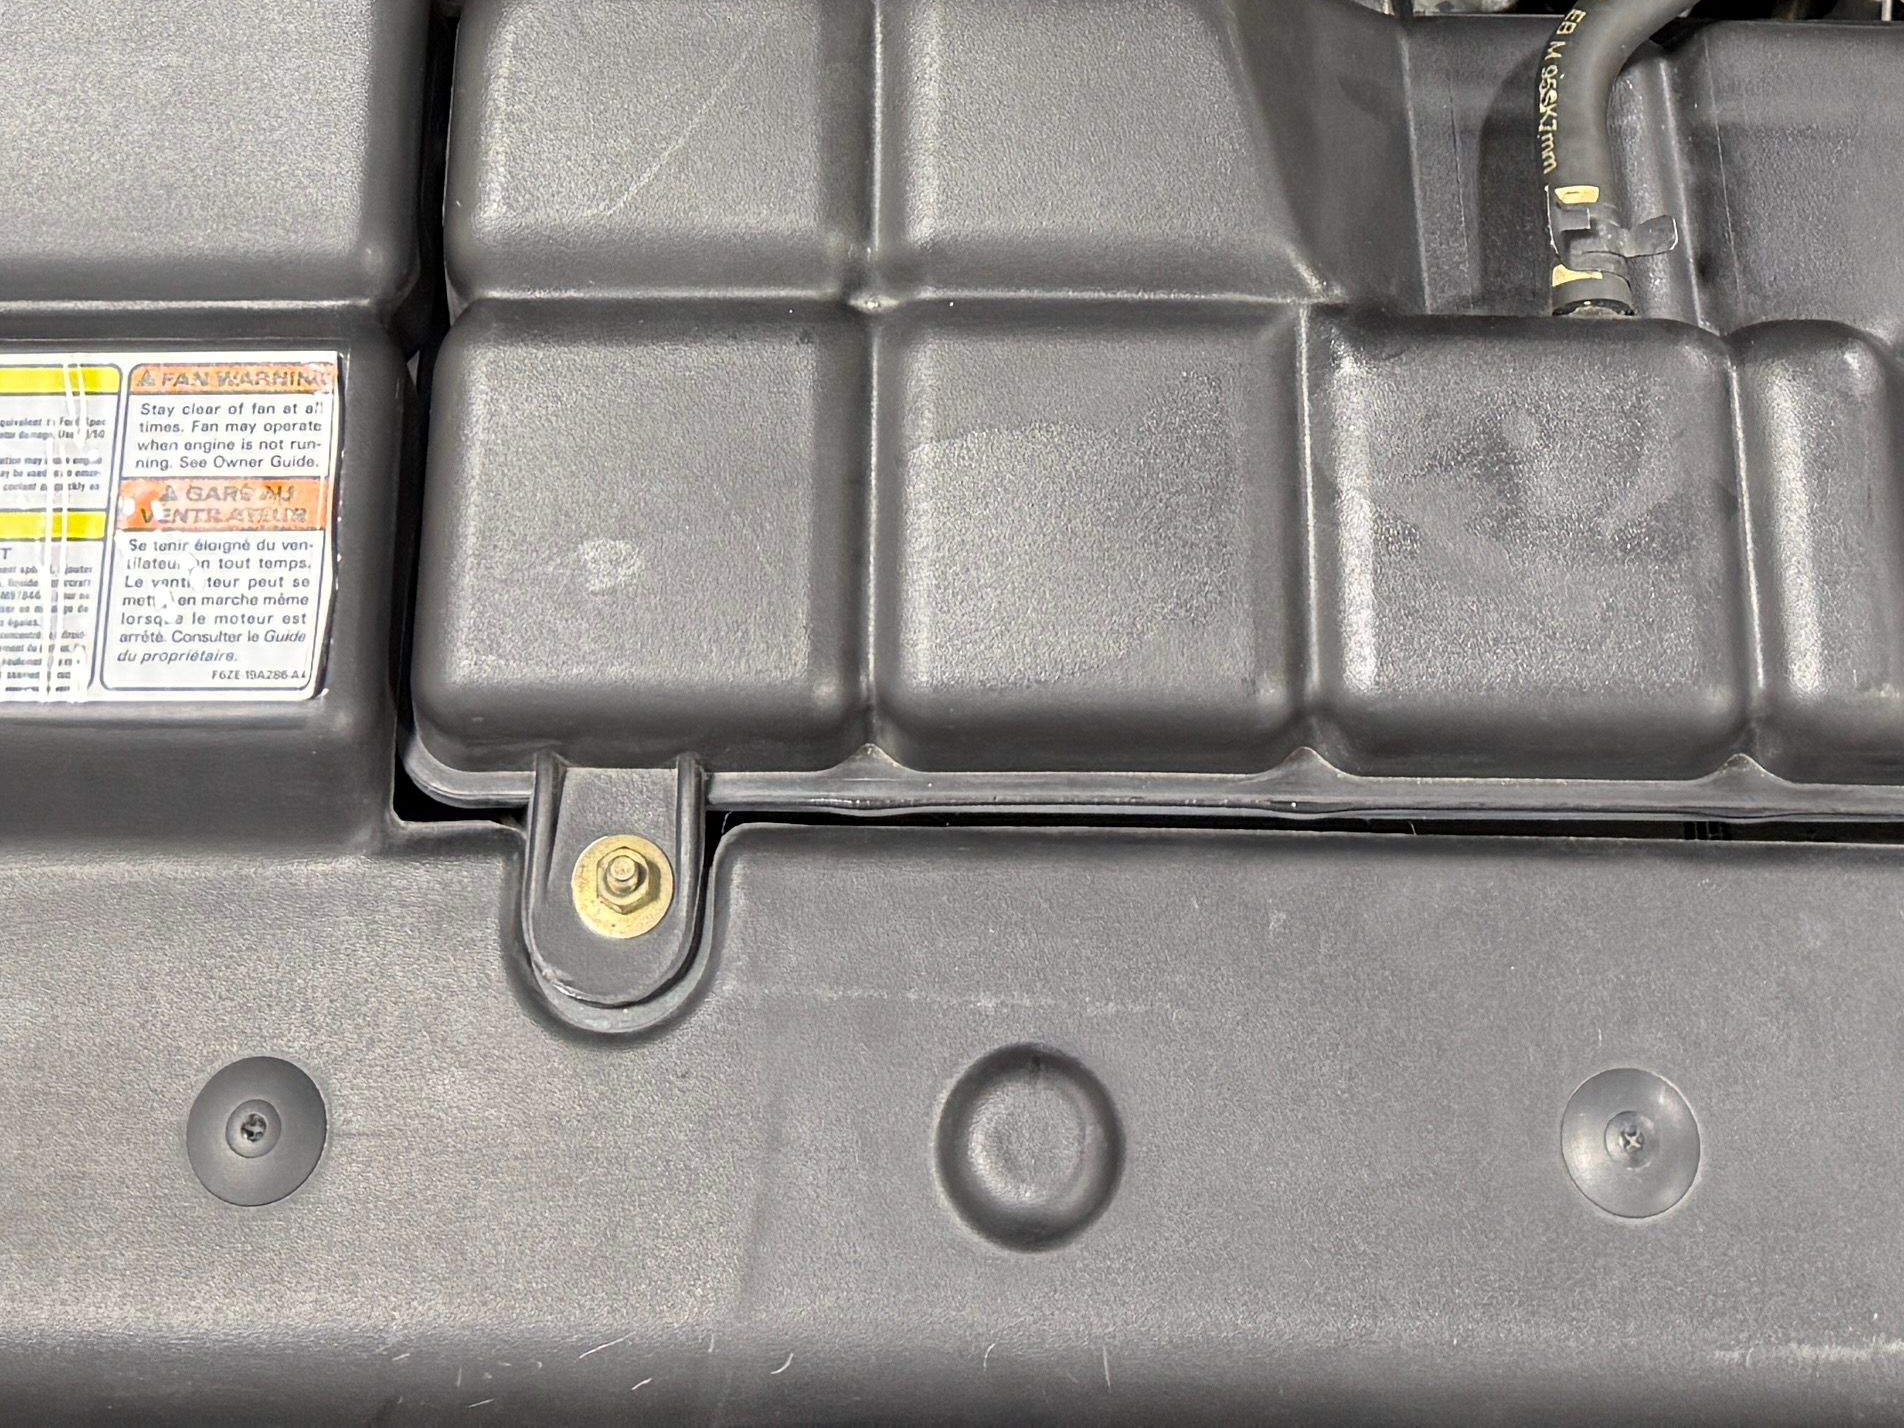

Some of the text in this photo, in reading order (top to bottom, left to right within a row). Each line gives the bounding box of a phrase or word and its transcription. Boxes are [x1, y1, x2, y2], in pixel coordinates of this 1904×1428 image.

[161, 371, 210, 386] FAN
[140, 401, 299, 419] Stay clear of fan at
[139, 420, 323, 437] times. Fan may operate
[137, 438, 323, 454] when engine is not run-
[135, 454, 321, 471] ning. See Owner Guide.
[154, 537, 315, 556] tenir éloigné du ven-
[218, 556, 313, 574] tout temps.
[124, 575, 284, 592] Le peut
[201, 593, 310, 607] marche même
[213, 612, 308, 626] moteur est
[171, 629, 307, 644] Consulter Guide
[116, 648, 239, 666] du propriétaire.
